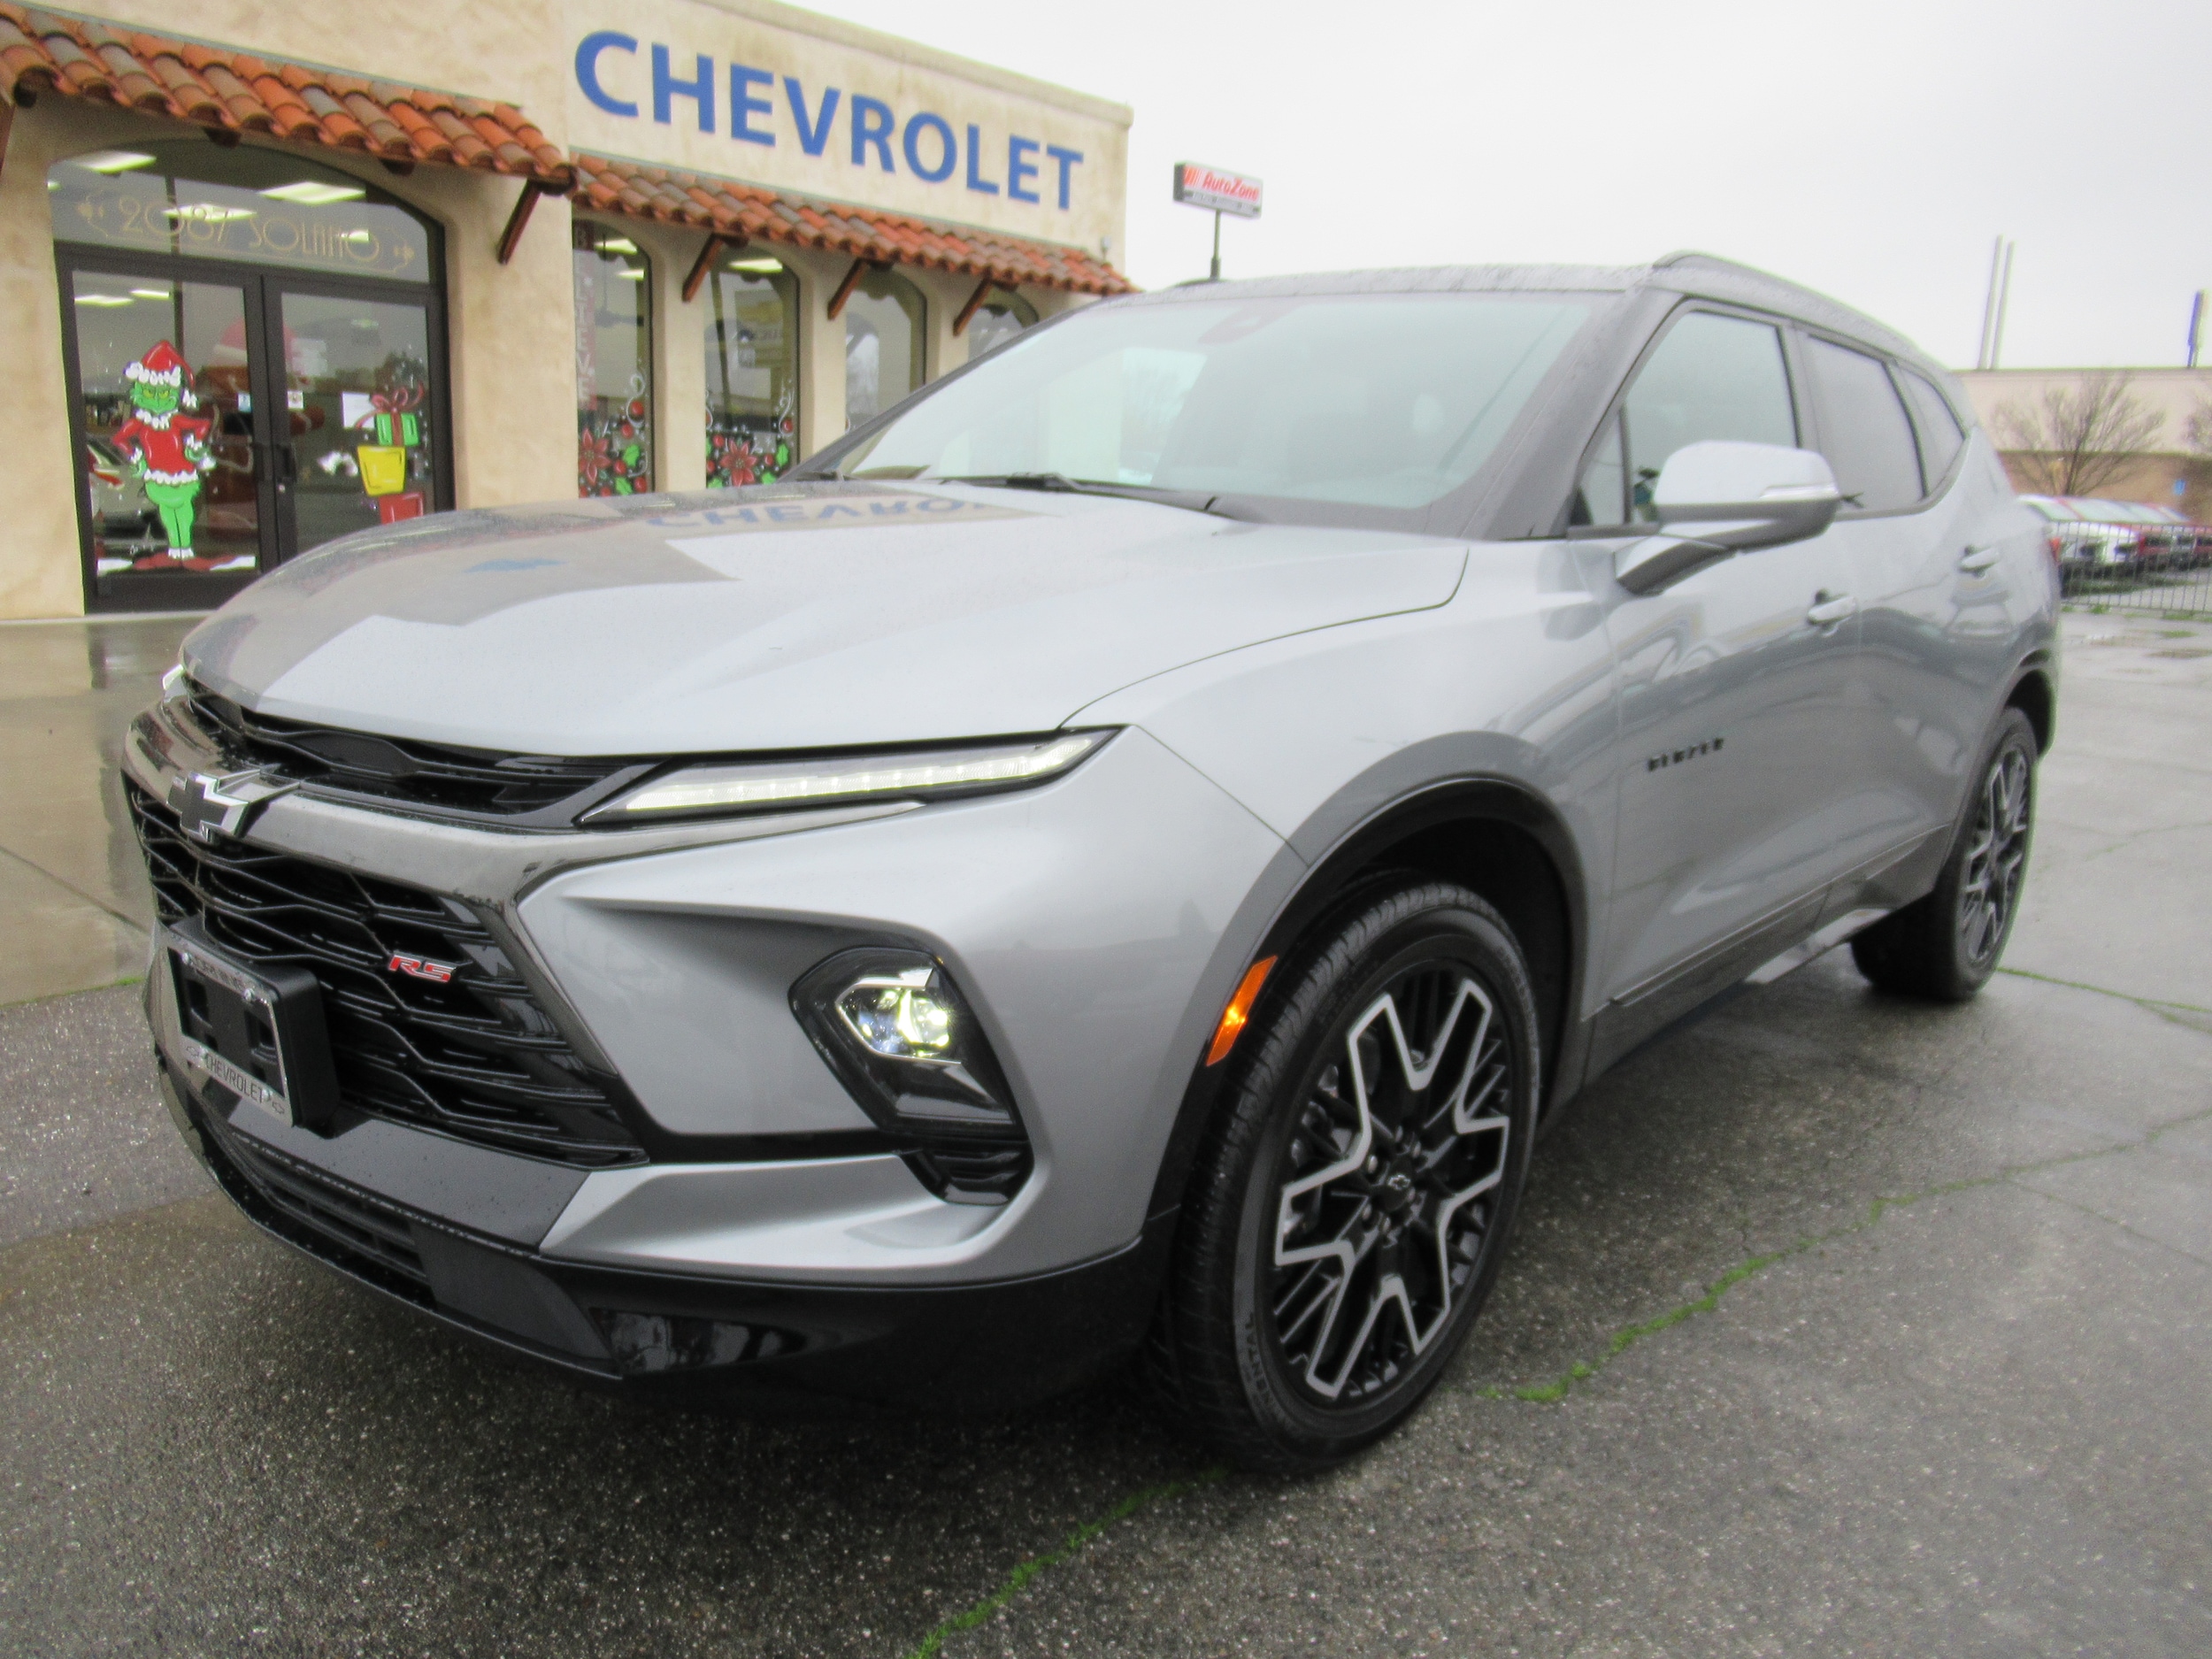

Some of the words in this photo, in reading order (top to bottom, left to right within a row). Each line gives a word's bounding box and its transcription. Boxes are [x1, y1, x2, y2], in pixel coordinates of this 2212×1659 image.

[573, 29, 1084, 211] CHEVROLET
[388, 955, 456, 983] RS
[205, 1053, 265, 1103] CHEVROLET
